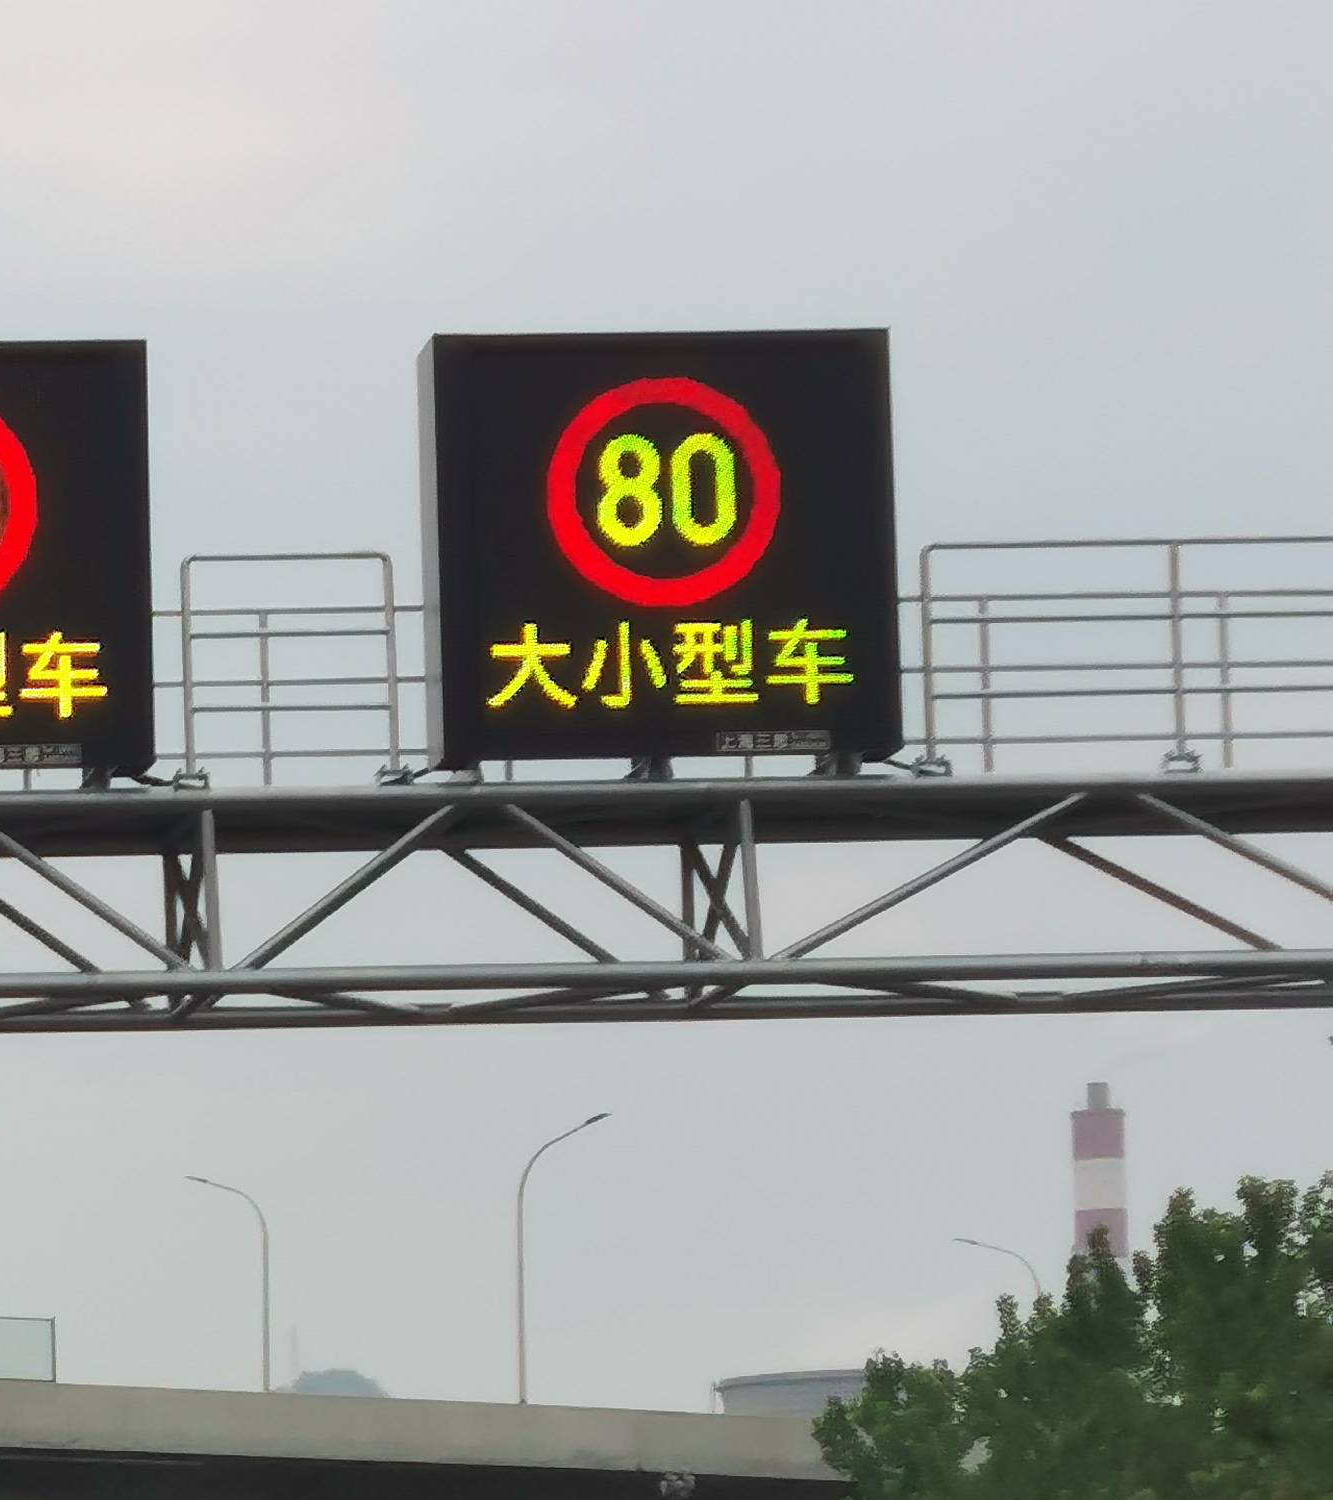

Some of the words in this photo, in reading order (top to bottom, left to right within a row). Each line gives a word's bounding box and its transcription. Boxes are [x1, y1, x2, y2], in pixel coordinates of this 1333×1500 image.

[597, 433, 737, 547] 80
[488, 619, 854, 708] 大小型车
